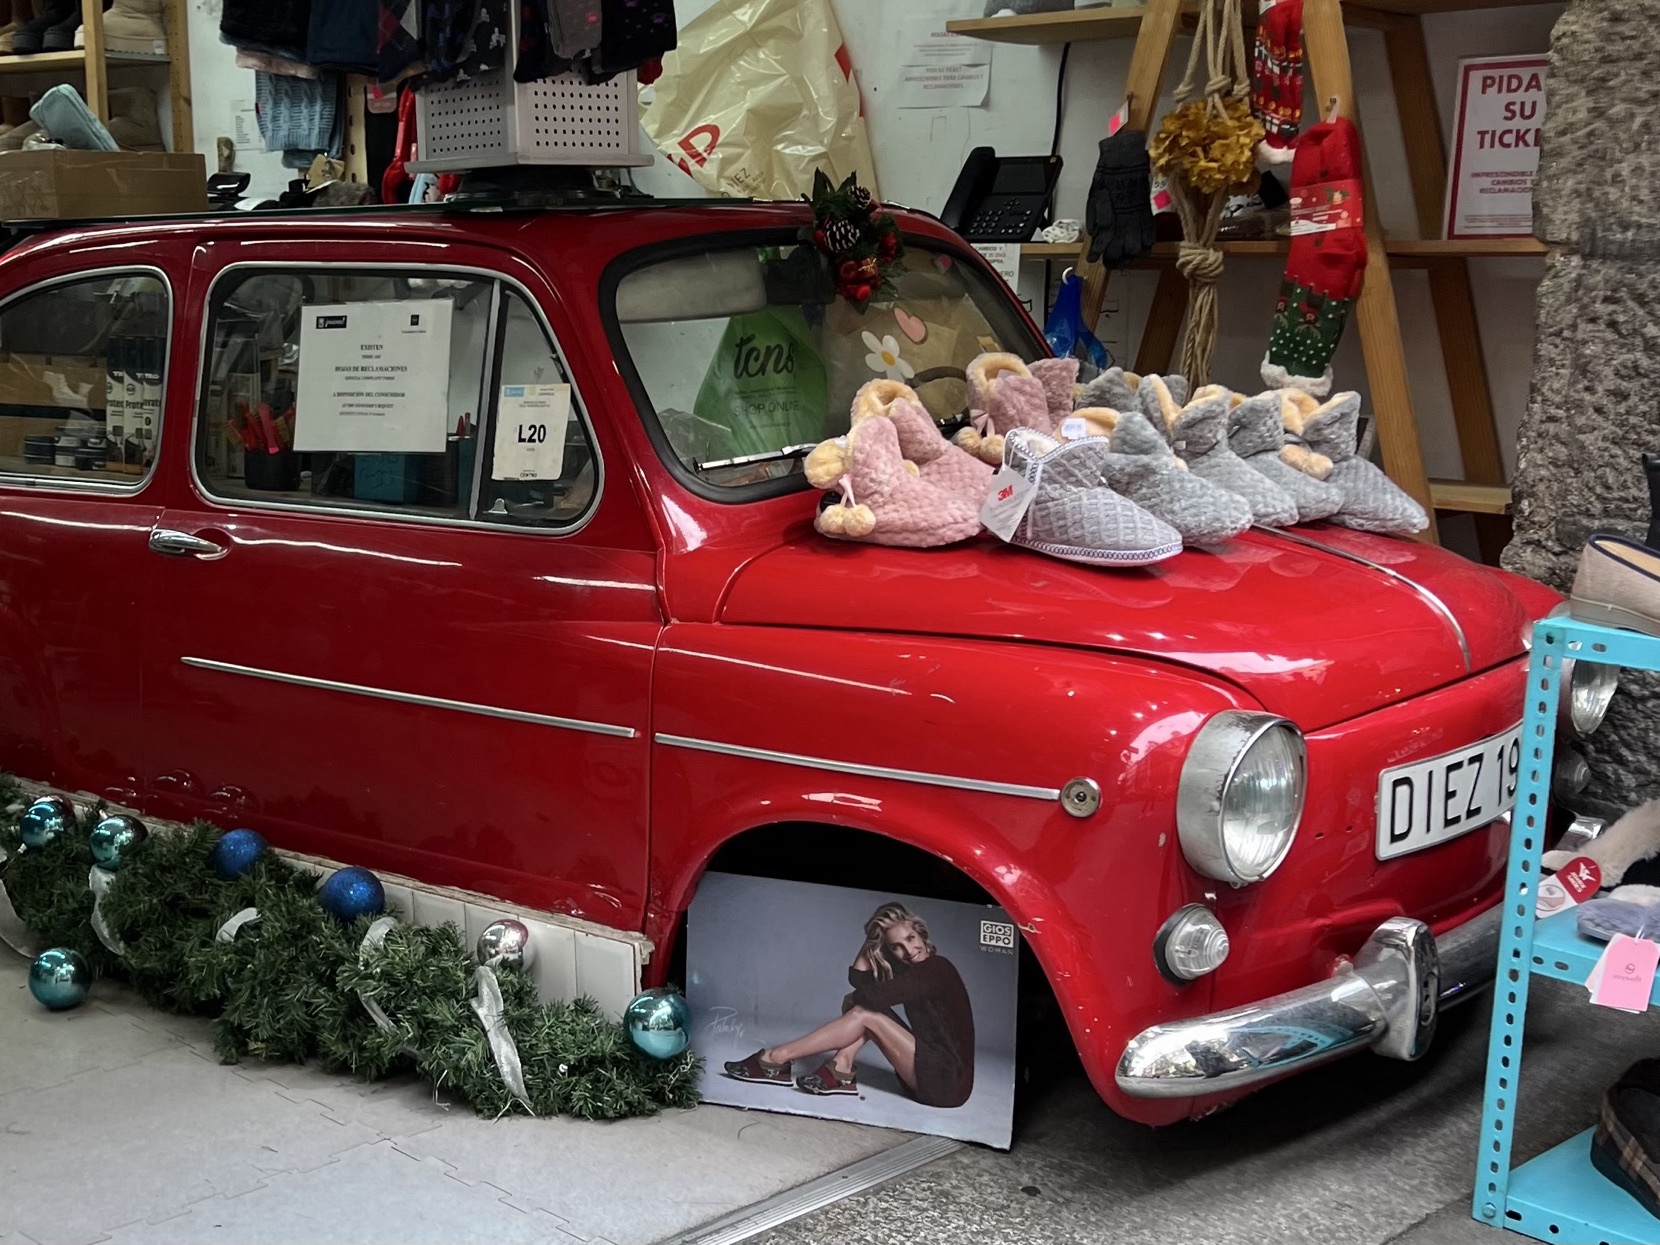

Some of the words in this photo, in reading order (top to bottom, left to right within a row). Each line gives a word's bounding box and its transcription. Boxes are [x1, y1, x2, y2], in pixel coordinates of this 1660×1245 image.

[1481, 73, 1542, 95] PIDA
[1503, 101, 1537, 121] SU
[518, 424, 546, 443] L20
[1390, 752, 1485, 844] DIEZ
[983, 924, 1011, 936] GIOS
[982, 934, 1011, 946] EPPO
